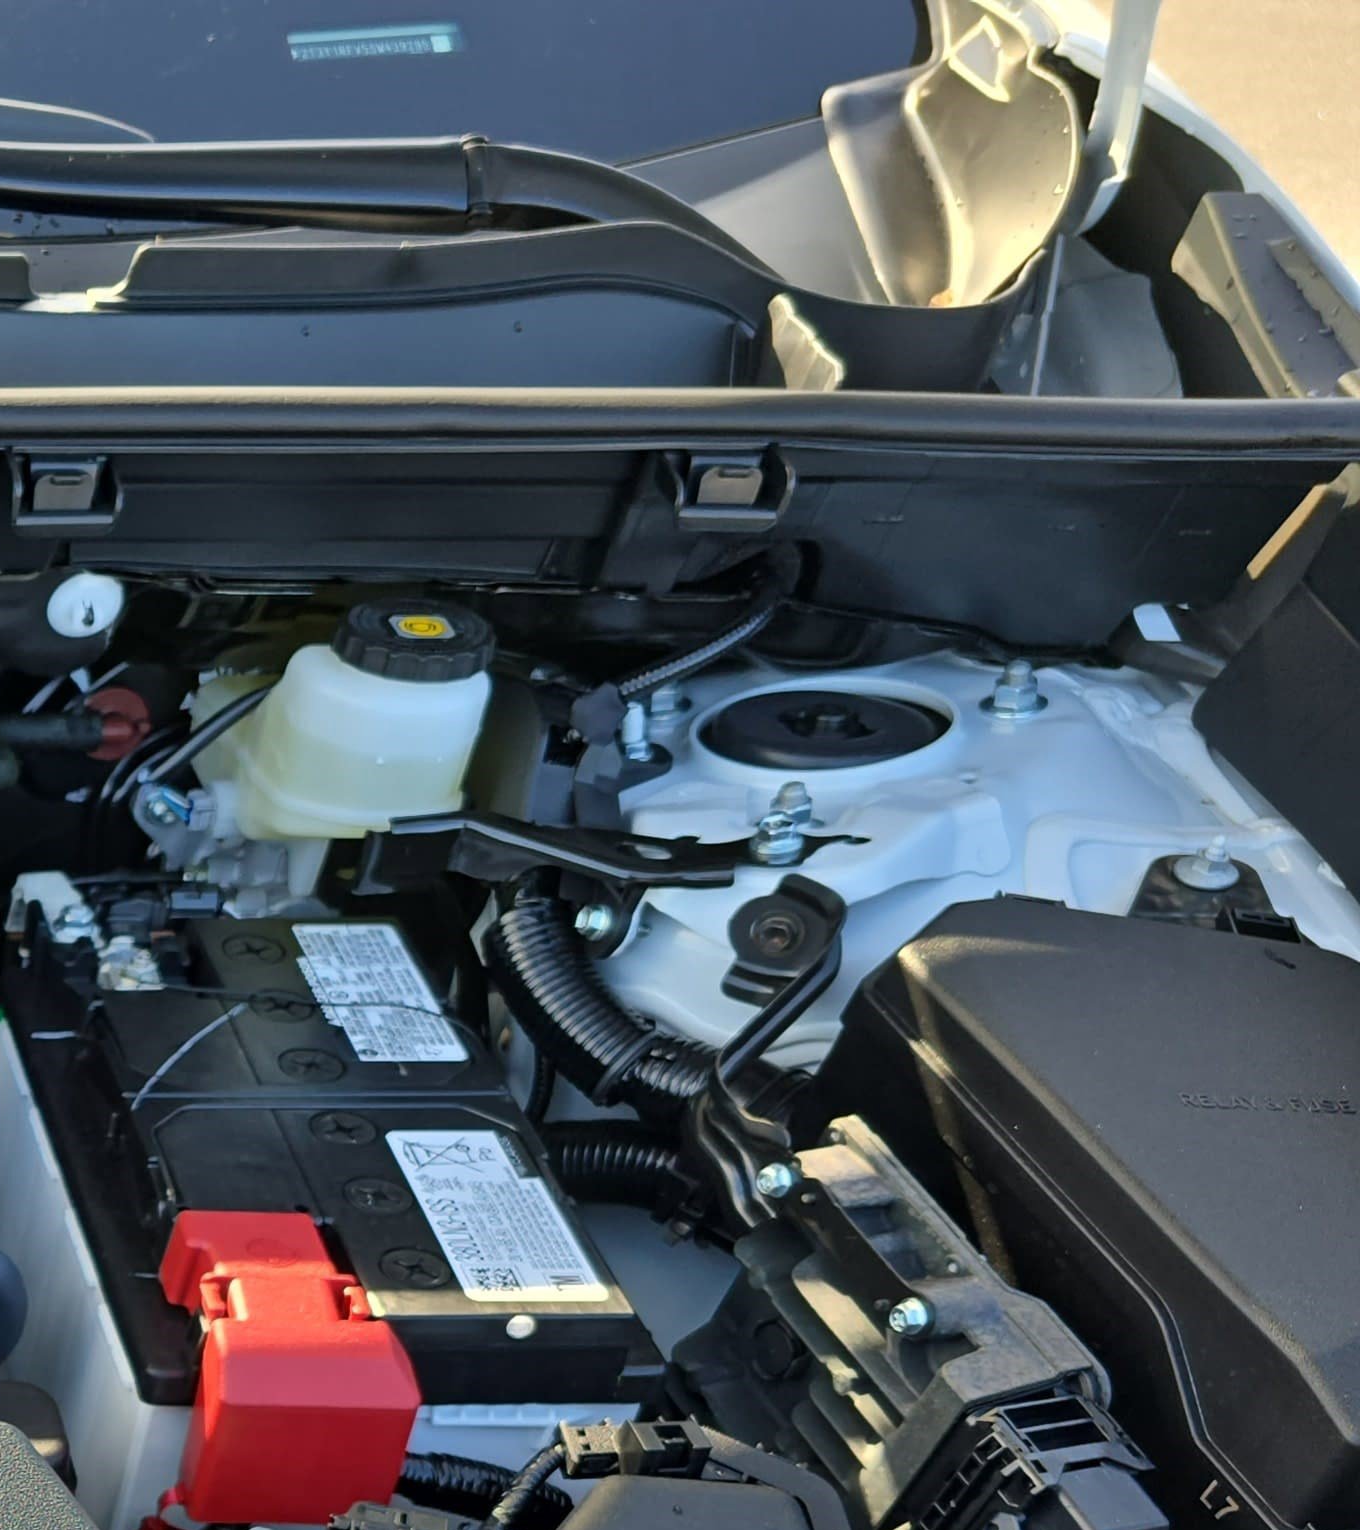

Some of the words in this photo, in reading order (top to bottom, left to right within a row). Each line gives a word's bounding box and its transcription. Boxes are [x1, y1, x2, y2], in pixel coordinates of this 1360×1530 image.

[1179, 1092, 1259, 1111] RELAY
[1287, 1097, 1358, 1115] FUSE
[1199, 1479, 1240, 1520] L7
